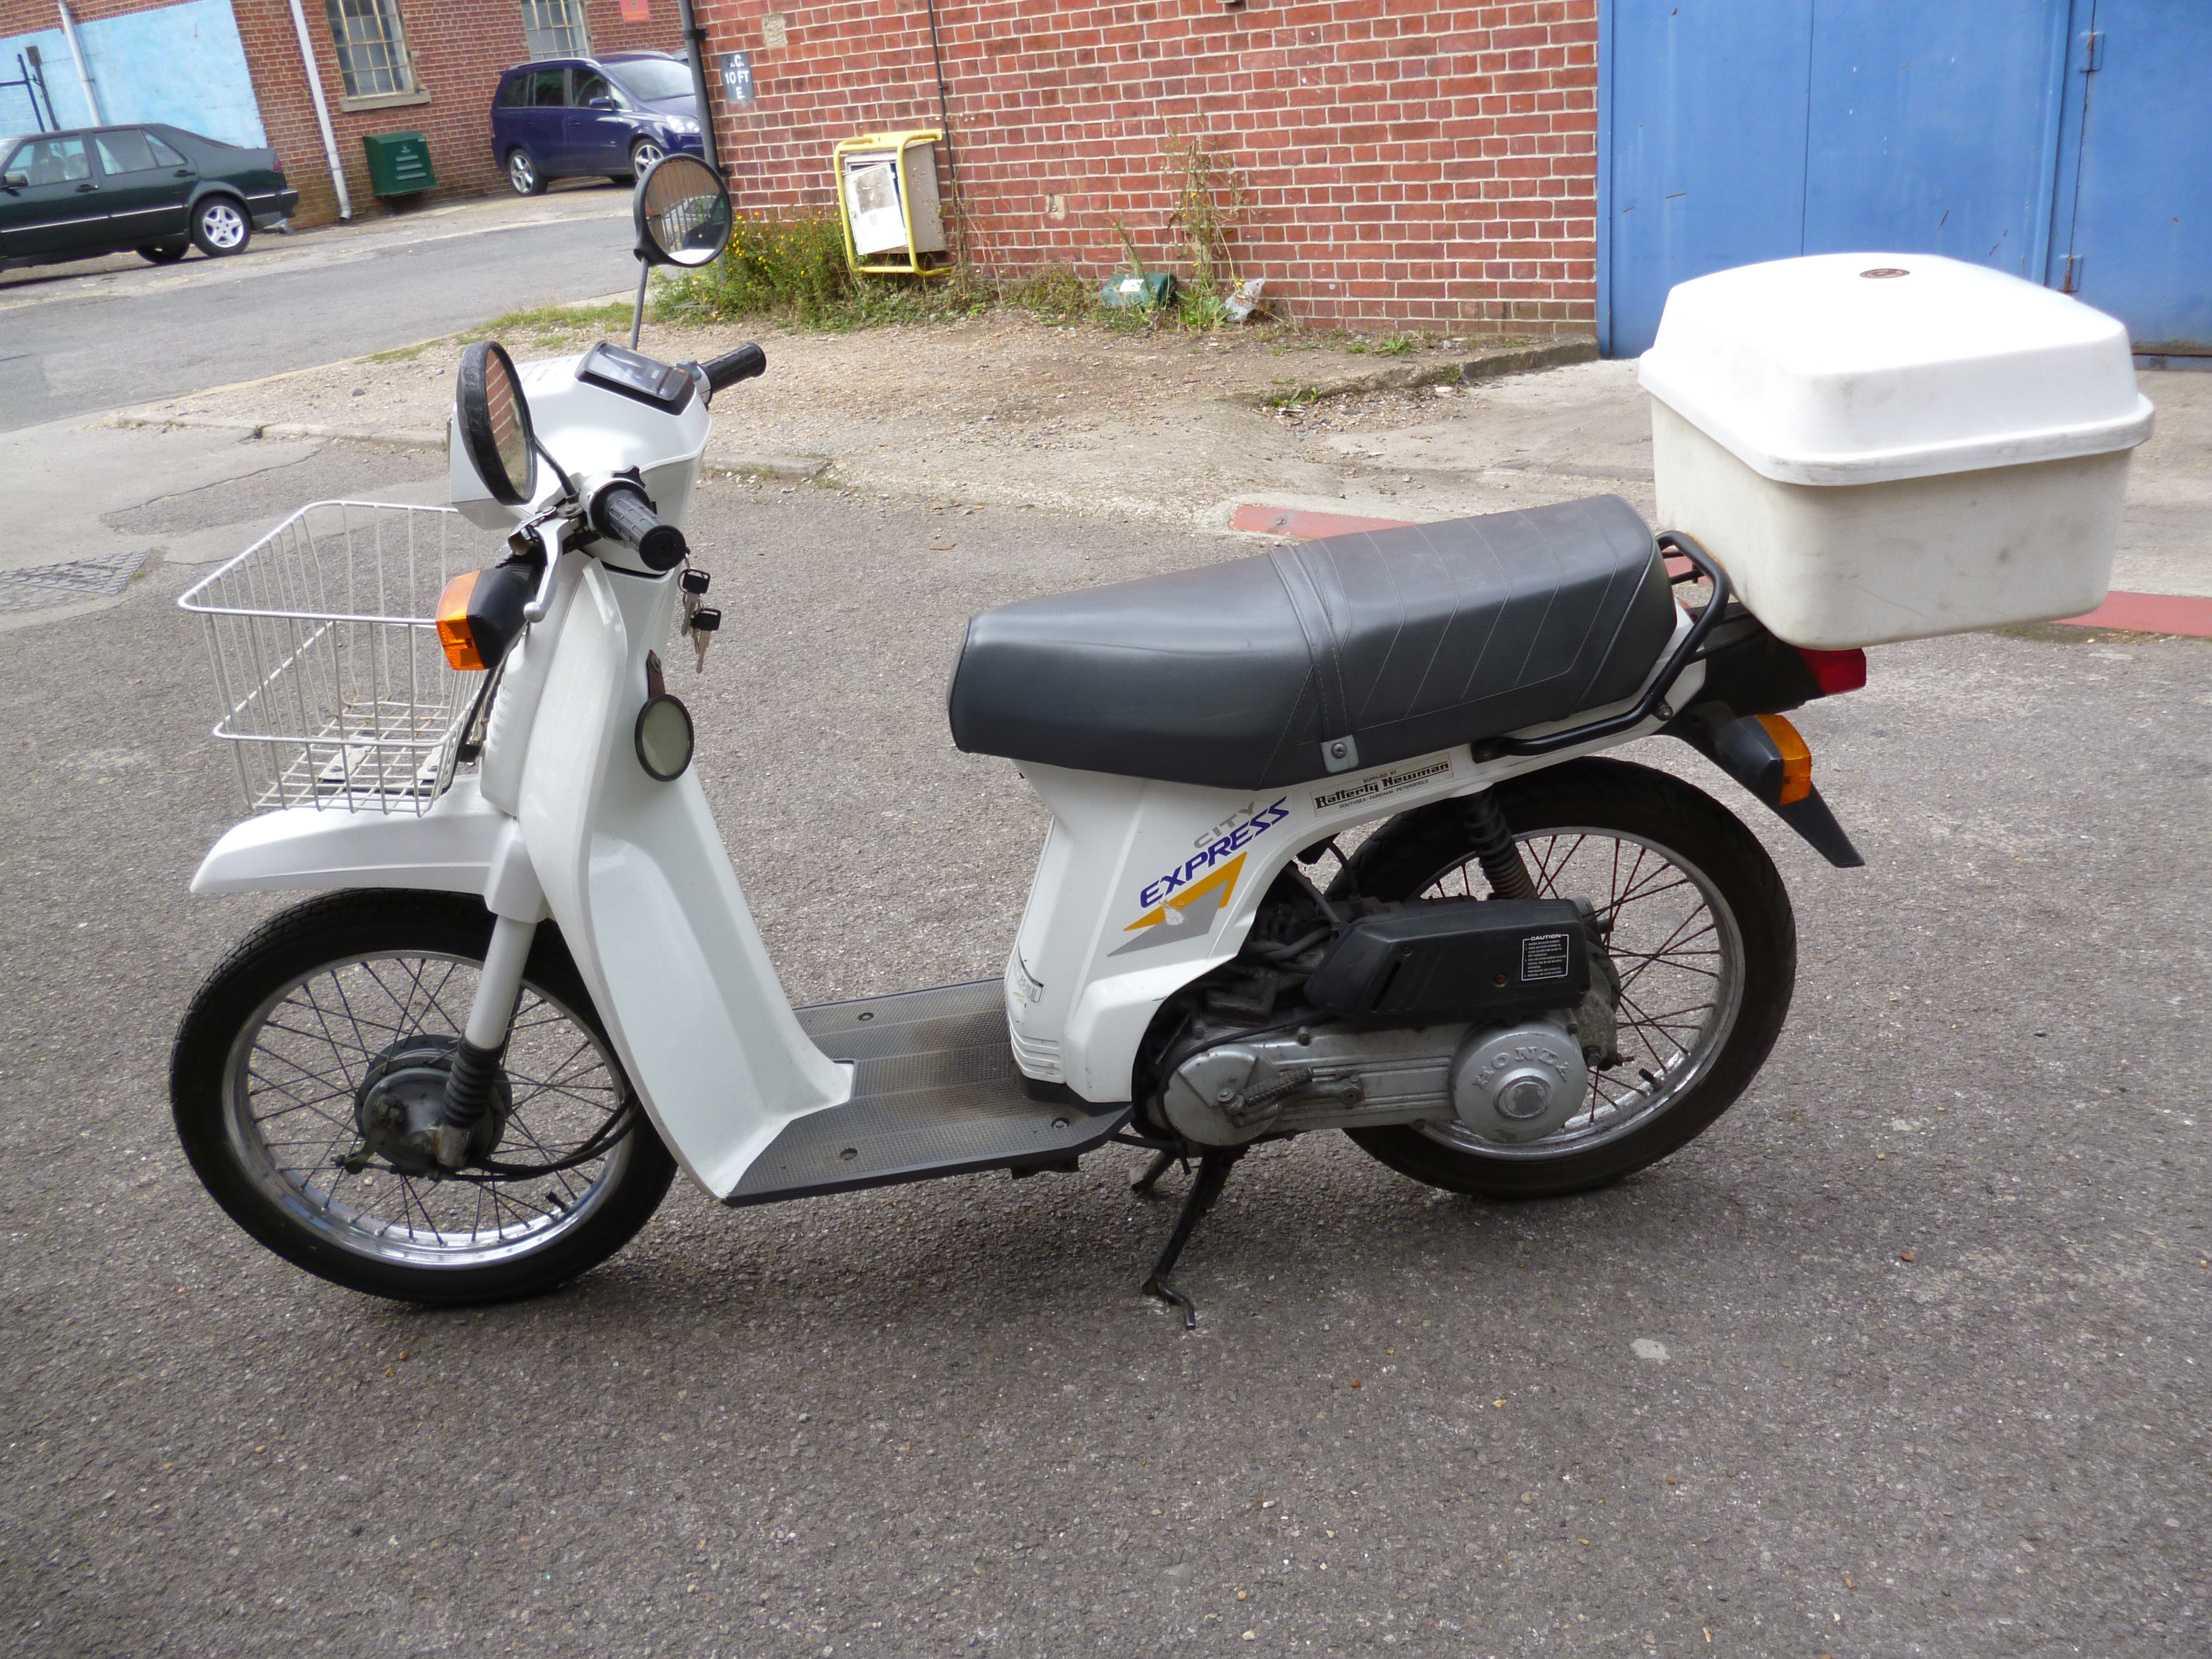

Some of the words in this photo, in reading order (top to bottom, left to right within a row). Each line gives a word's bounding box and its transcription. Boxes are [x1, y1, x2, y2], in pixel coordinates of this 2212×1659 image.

[725, 72, 736, 84] 10
[737, 71, 749, 83] FT
[736, 87, 746, 99] E.
[1363, 773, 1388, 783] SUPPLIED
[1381, 761, 1450, 790] Newman
[1339, 798, 1366, 809] SOUTHSEA
[1369, 789, 1393, 800] FAREHAM
[1396, 779, 1429, 792] PETERSFIELD
[1194, 800, 1254, 848] CITY
[1140, 795, 1289, 908] EXPRESS
[1473, 1046, 1569, 1090] HONDA
